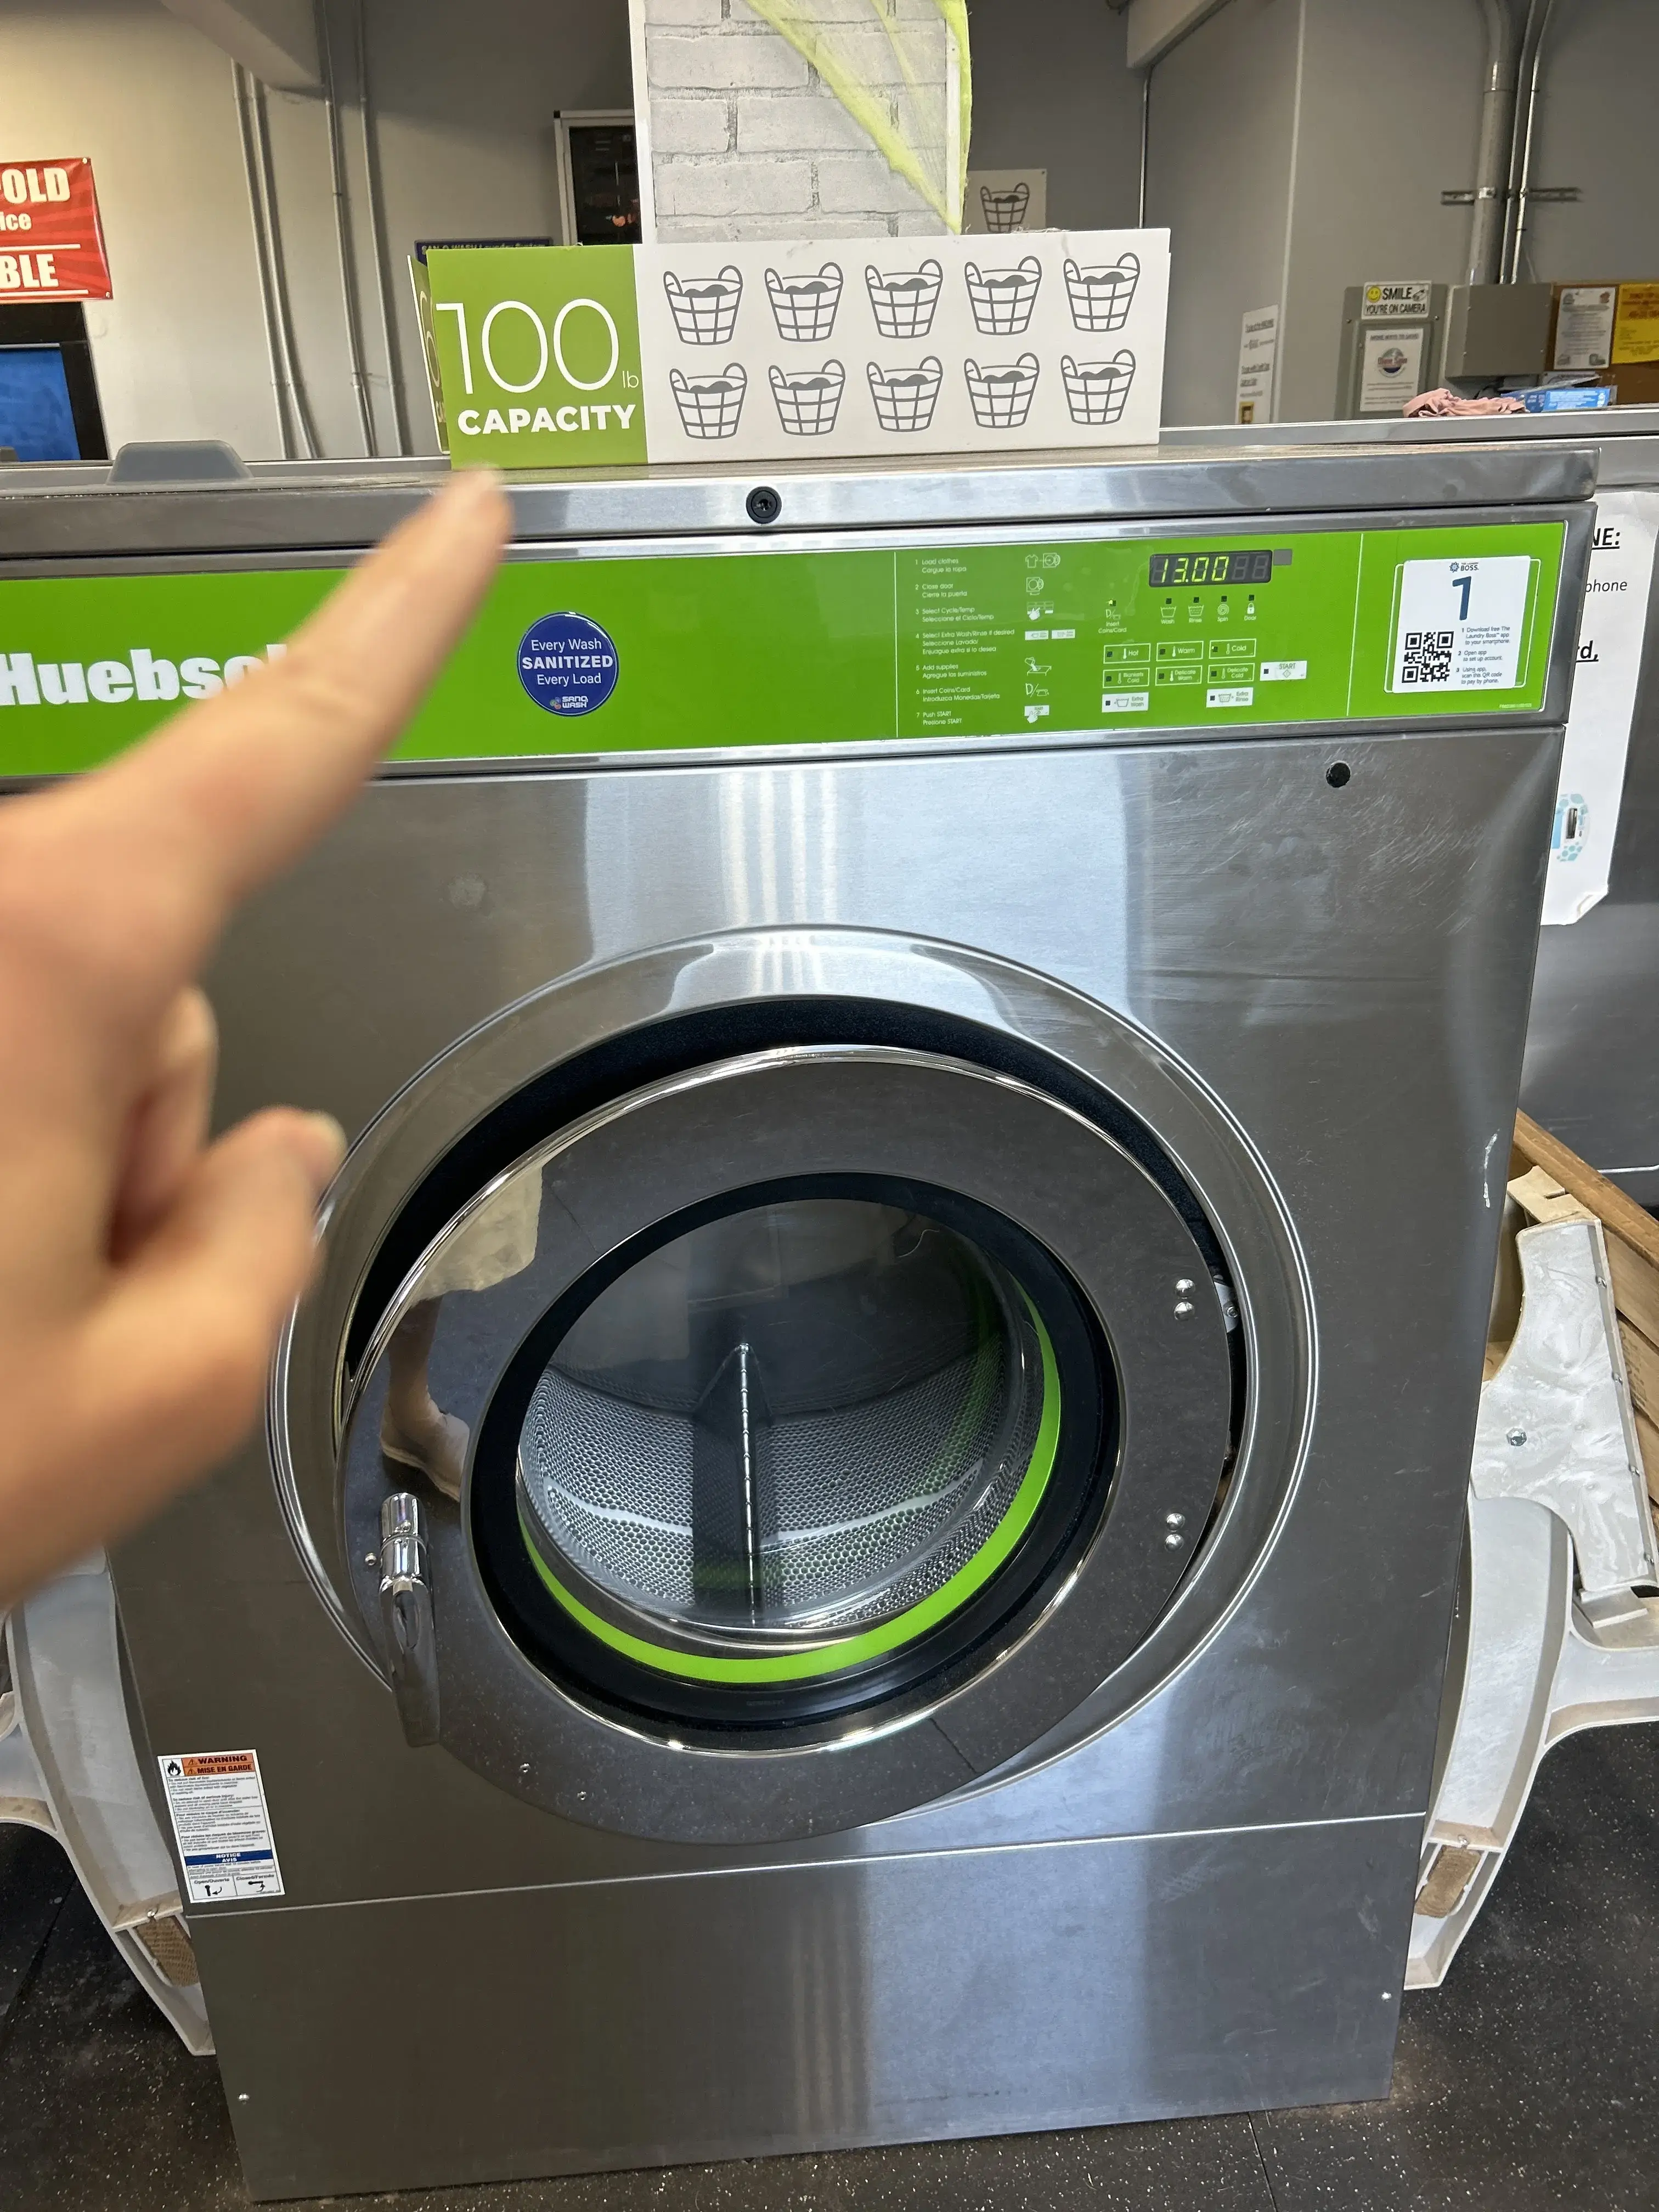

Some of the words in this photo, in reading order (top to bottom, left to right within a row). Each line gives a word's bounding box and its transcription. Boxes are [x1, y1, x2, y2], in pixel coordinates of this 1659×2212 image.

[0, 167, 71, 204] OLD
[1383, 287, 1413, 300] SMILE
[436, 298, 619, 394] 100
[622, 370, 639, 388] lb
[458, 404, 636, 435] CAPACITY
[1161, 556, 1229, 583] 13.00
[1452, 575, 1472, 620] 1
[531, 639, 565, 653] Every
[567, 637, 602, 651] Wash
[522, 655, 613, 670] SANITIZED
[0, 644, 287, 706] Huebsc
[537, 674, 569, 687] Every
[573, 673, 602, 685] Load
[197, 1766, 216, 1774] MISE
[198, 1755, 248, 1764] WARNING
